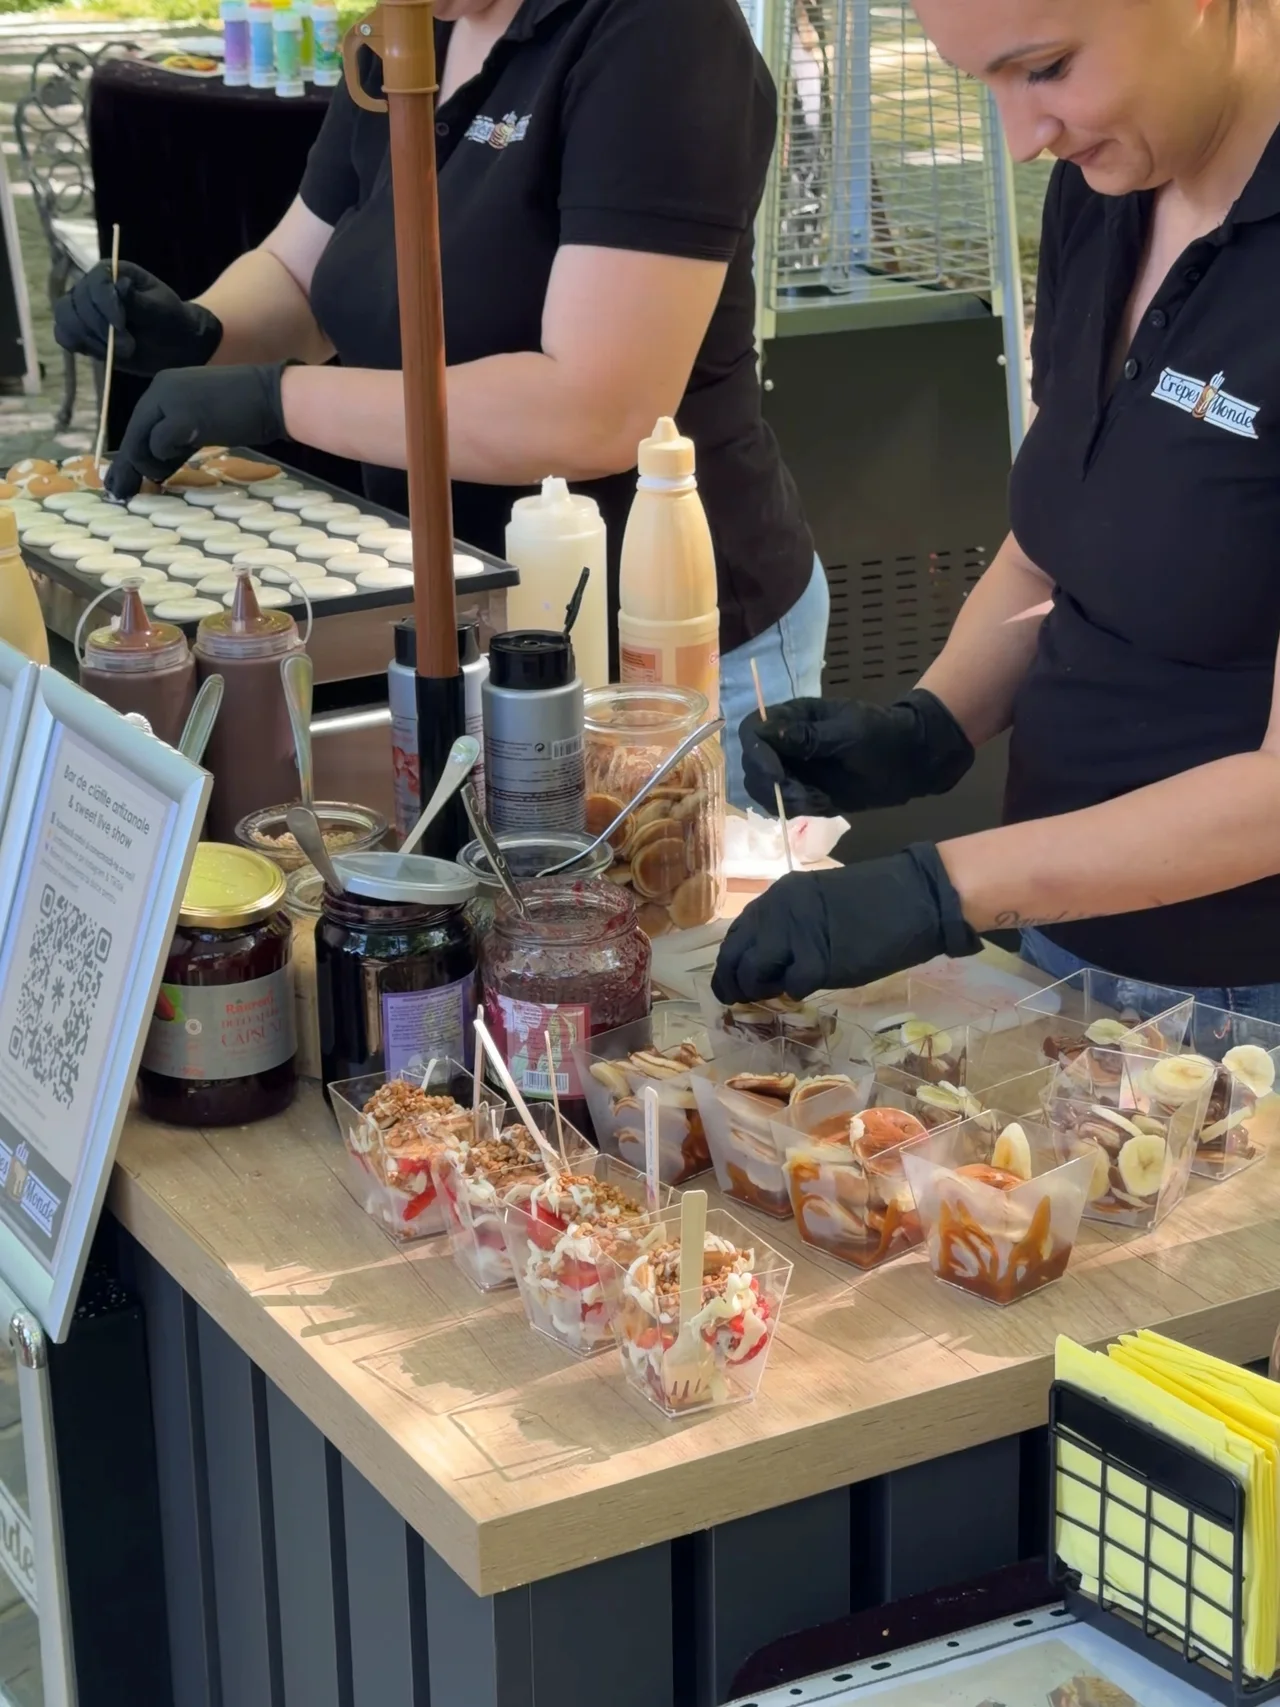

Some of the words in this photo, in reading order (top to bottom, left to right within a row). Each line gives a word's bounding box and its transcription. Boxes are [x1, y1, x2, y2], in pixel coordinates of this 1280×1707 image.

[1210, 394, 1252, 428] Monde
[63, 764, 77, 783] Bar
[76, 774, 88, 792] de
[111, 801, 150, 835] artizanale
[68, 794, 75, 809] &
[74, 801, 97, 825] sweet
[97, 813, 111, 835] live
[111, 826, 133, 849] show
[26, 1177, 54, 1223] Monde
